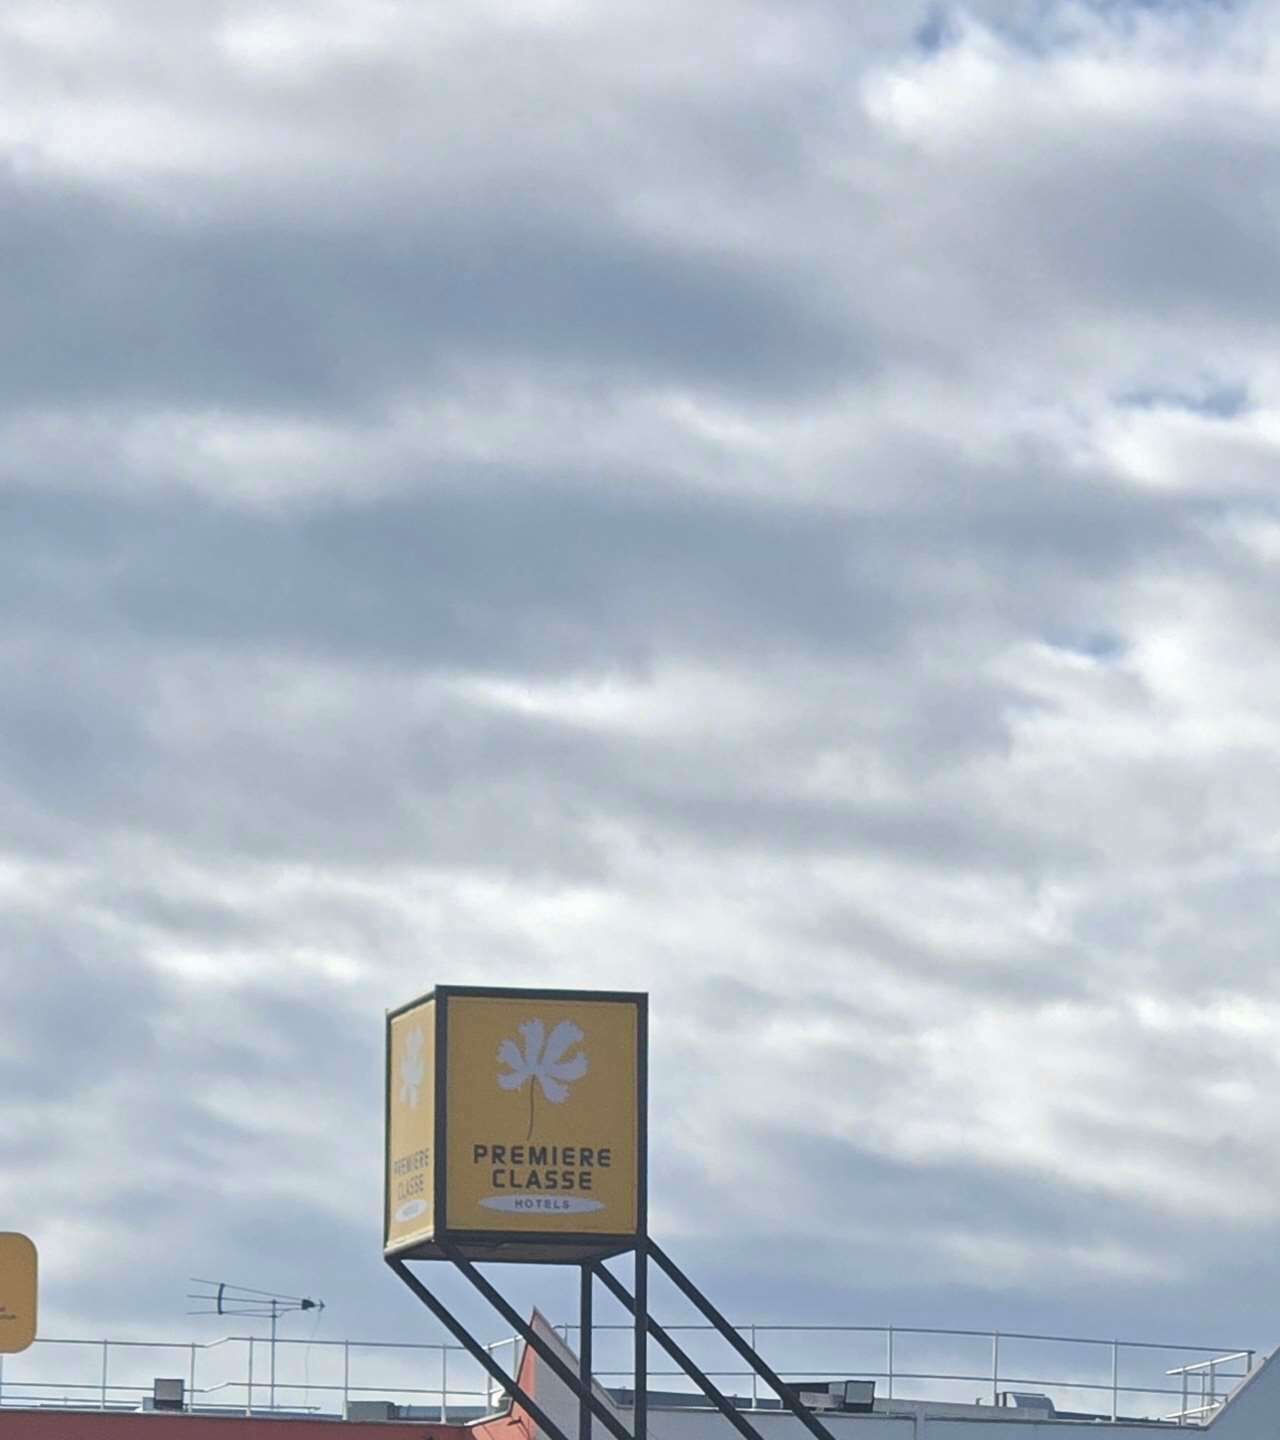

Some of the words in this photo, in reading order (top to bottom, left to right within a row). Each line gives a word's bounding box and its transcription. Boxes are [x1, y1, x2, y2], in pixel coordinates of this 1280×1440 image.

[473, 1144, 612, 1168] PREMIERE
[492, 1168, 593, 1190] CLASSE
[514, 1198, 570, 1209] HOTELS
